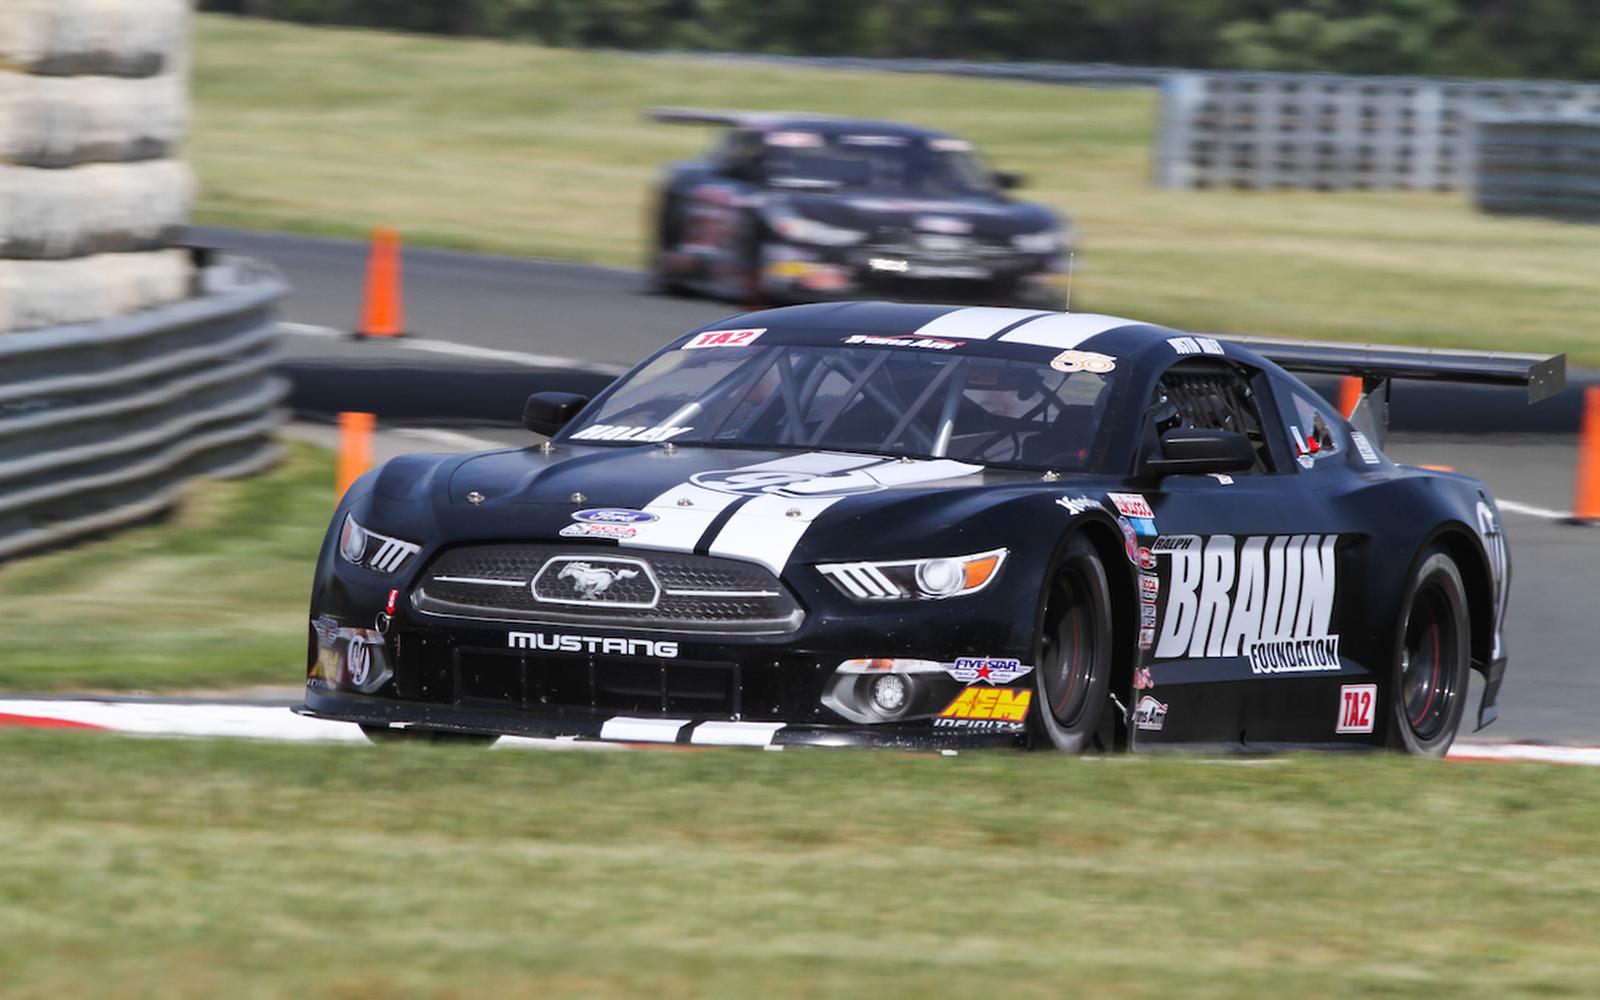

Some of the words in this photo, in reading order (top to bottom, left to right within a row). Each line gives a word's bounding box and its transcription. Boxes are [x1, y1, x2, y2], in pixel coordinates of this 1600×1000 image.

[696, 331, 754, 346] TA2
[589, 511, 641, 522] Ford
[1154, 537, 1194, 550] RALPH
[1154, 535, 1338, 658] BRAUN
[508, 631, 678, 658] MUSTANG
[1250, 638, 1339, 671] FOUNDATION
[955, 660, 984, 669] FIVE
[986, 660, 1017, 672] STAR
[937, 687, 1032, 722] AEM
[1344, 692, 1371, 727] TA2
[933, 719, 1024, 730] INFINITY
